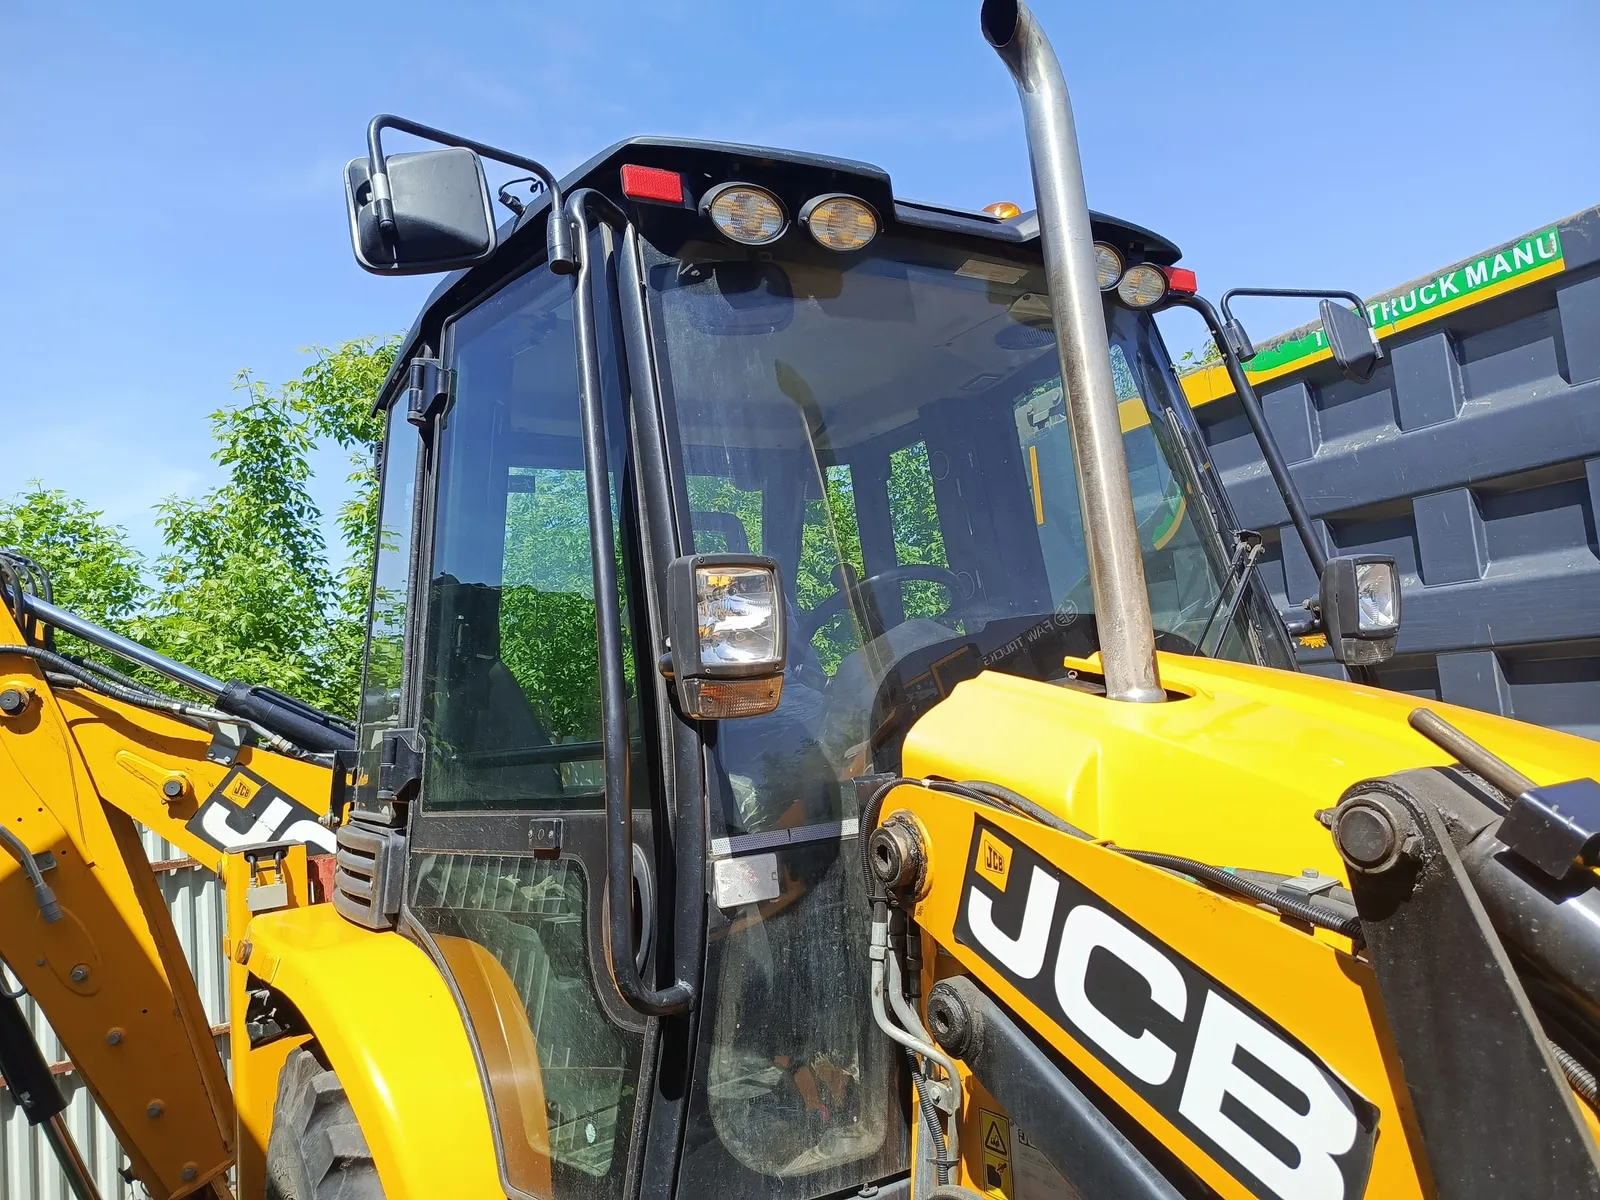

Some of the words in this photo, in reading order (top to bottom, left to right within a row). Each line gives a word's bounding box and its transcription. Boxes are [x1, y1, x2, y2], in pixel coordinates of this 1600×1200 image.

[1367, 273, 1460, 325] TRUCK
[1465, 232, 1558, 288] MANU
[233, 782, 250, 797] JCB
[986, 846, 1005, 872] JCB
[968, 865, 1357, 1200] JCB
